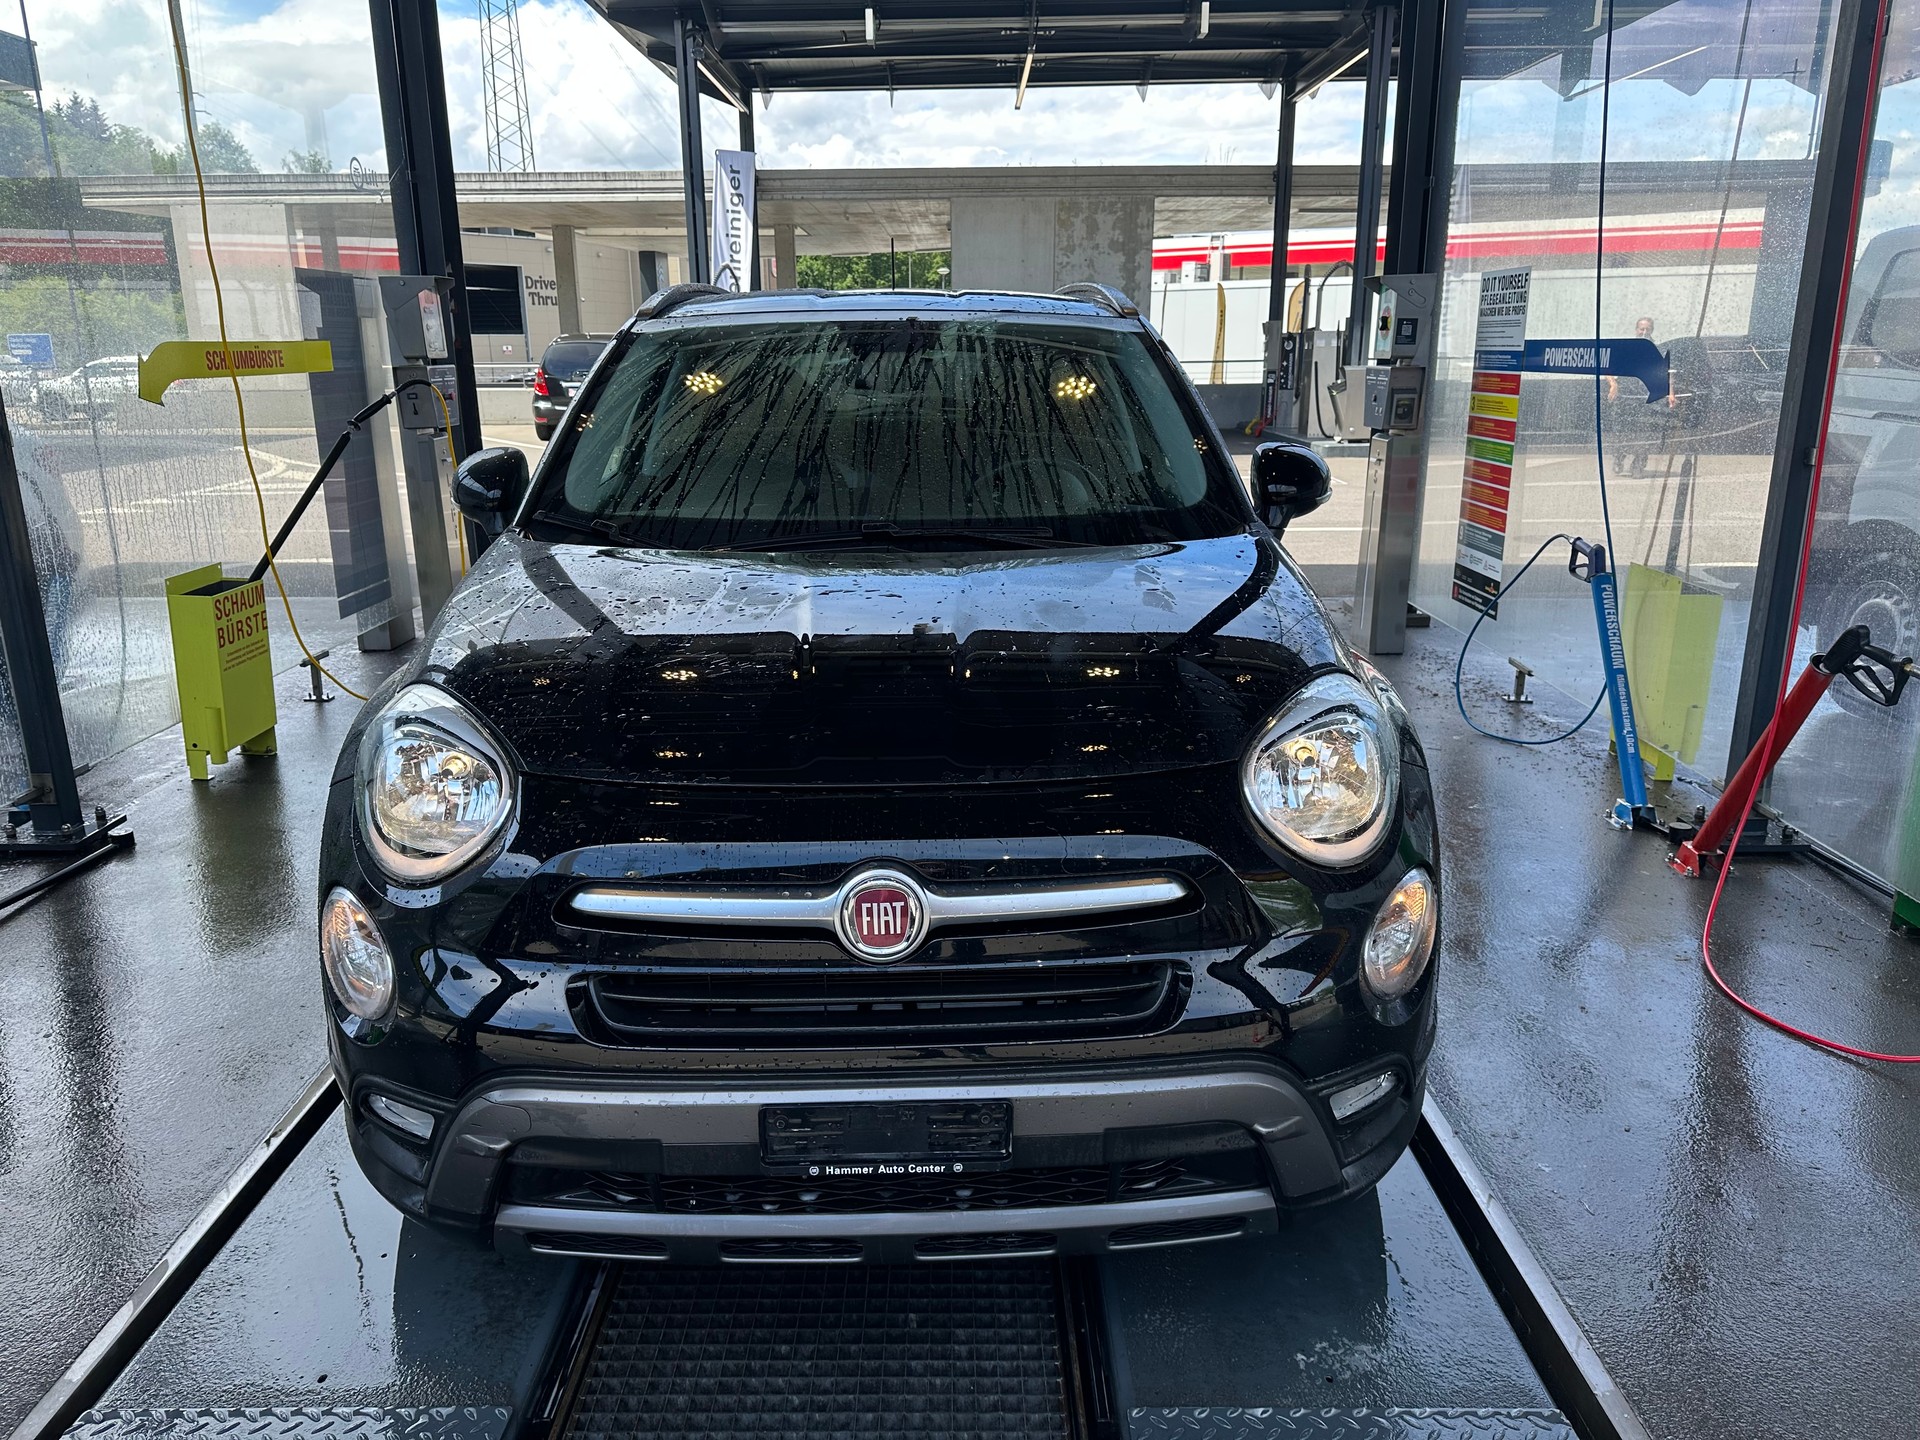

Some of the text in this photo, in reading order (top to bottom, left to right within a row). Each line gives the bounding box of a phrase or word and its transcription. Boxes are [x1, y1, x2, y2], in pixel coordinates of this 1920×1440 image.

[524, 275, 556, 290] Drive
[1482, 272, 1529, 293] DO IT YOURSELF
[528, 292, 558, 306] Thru
[1480, 290, 1527, 306] PFLEGEANLEITUNG
[214, 583, 265, 621] SCHAUM
[217, 609, 268, 649] BÜRSTE
[1600, 583, 1625, 669] POWERSCHAUM
[861, 901, 905, 936] FIAT
[825, 1165, 874, 1175] Hammer
[878, 1164, 905, 1174] Auto
[908, 1163, 946, 1173] Center
